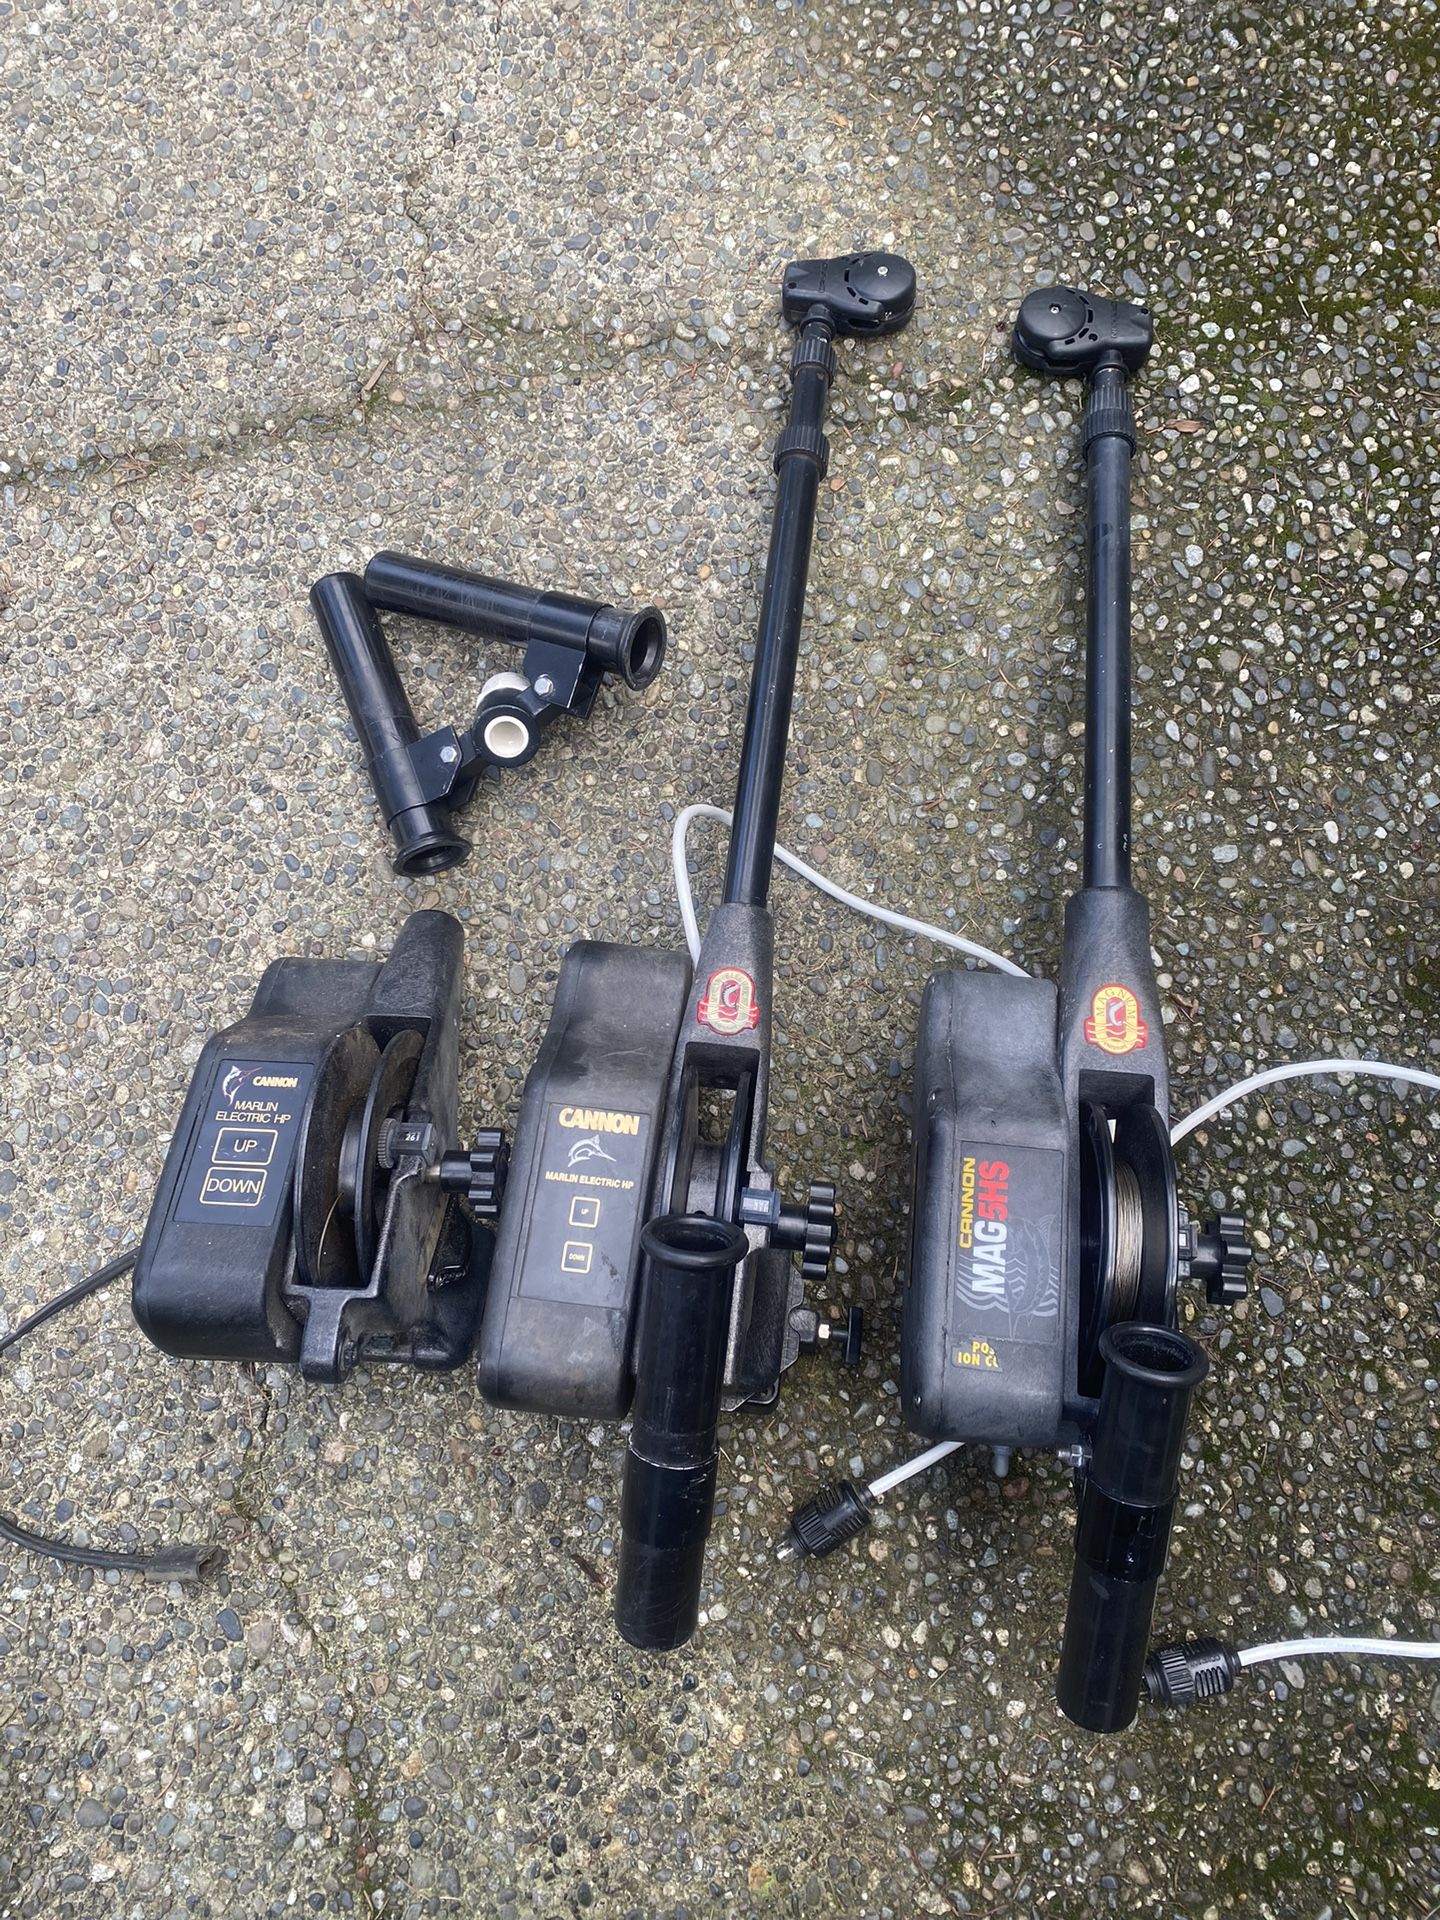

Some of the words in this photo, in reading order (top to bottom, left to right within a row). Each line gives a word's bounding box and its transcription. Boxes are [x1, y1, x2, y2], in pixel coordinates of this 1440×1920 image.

[252, 1076, 298, 1088] CANNON
[234, 1100, 279, 1112] MARLIN
[215, 1110, 271, 1123] ELECTRIC
[273, 1113, 292, 1124] HP
[559, 1107, 640, 1135] CANNON
[233, 1139, 258, 1152] UP
[206, 1178, 261, 1194] DOWN
[545, 1171, 578, 1182] MARLIN
[579, 1175, 621, 1188] ELECTRIC
[621, 1180, 634, 1190] HP
[959, 1157, 976, 1249] CANNON
[581, 1207, 589, 1215] UP
[569, 1252, 585, 1261] DOWN
[958, 1351, 980, 1366] ION
